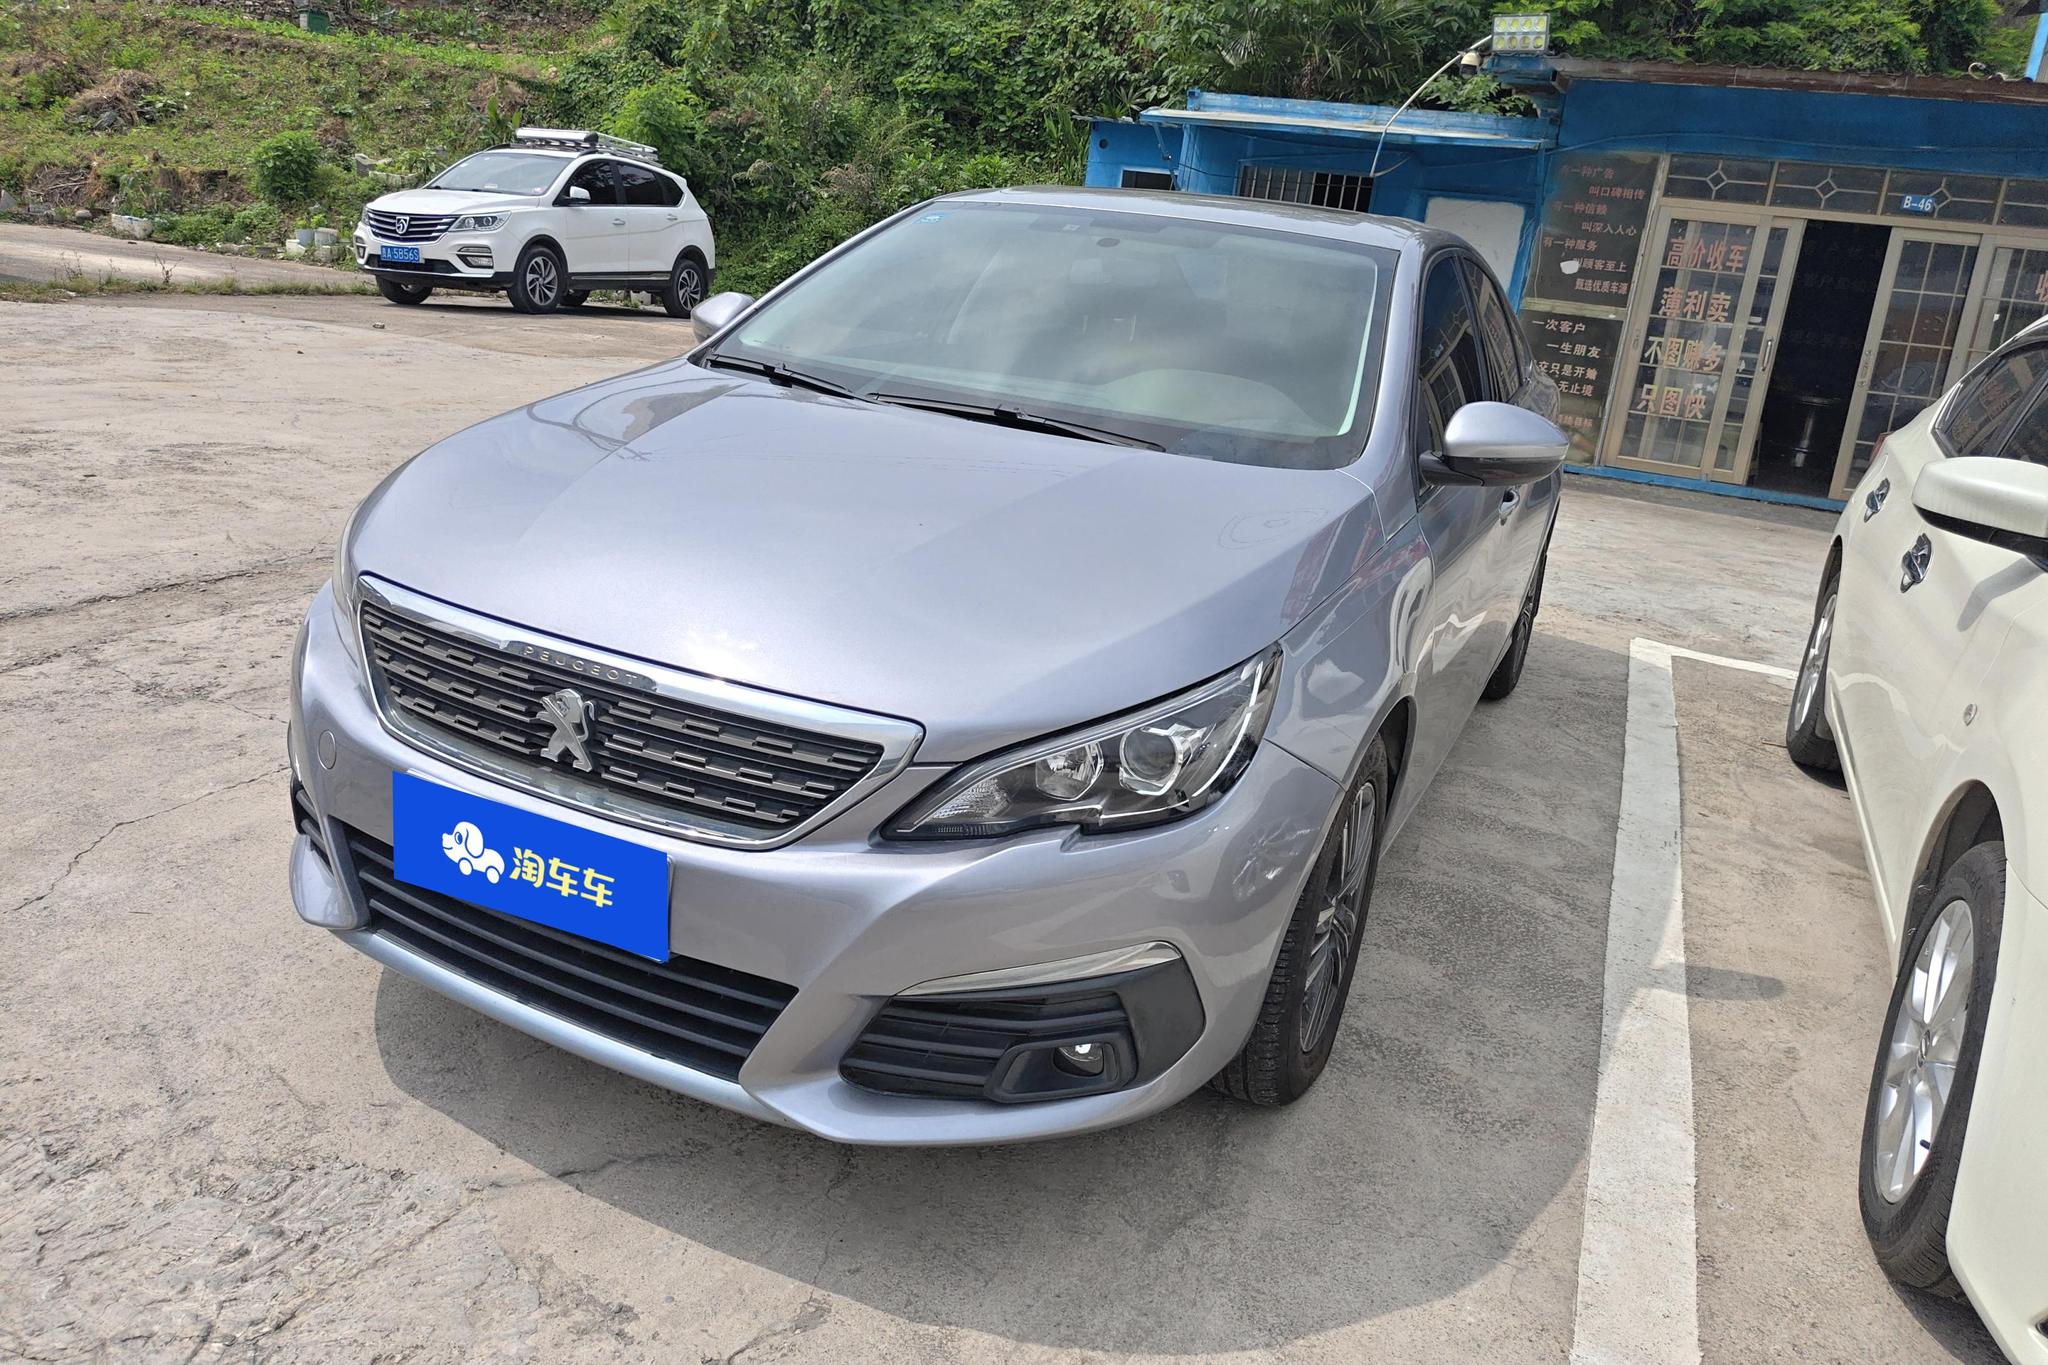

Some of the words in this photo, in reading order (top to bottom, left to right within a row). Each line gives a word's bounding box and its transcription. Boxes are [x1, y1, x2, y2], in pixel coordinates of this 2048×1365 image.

[1588, 185, 1646, 200] 叫口碑相传
[1903, 194, 1933, 212] B-46
[1581, 221, 1637, 237] 叫深入人心
[1543, 236, 1597, 252] 有一种服务
[1666, 236, 1748, 272] 高价收车
[1532, 318, 1586, 334] 一次客户
[1546, 341, 1601, 359] 一生朋友
[1637, 384, 1706, 419] 只图快
[522, 645, 640, 687] PEUGEOT
